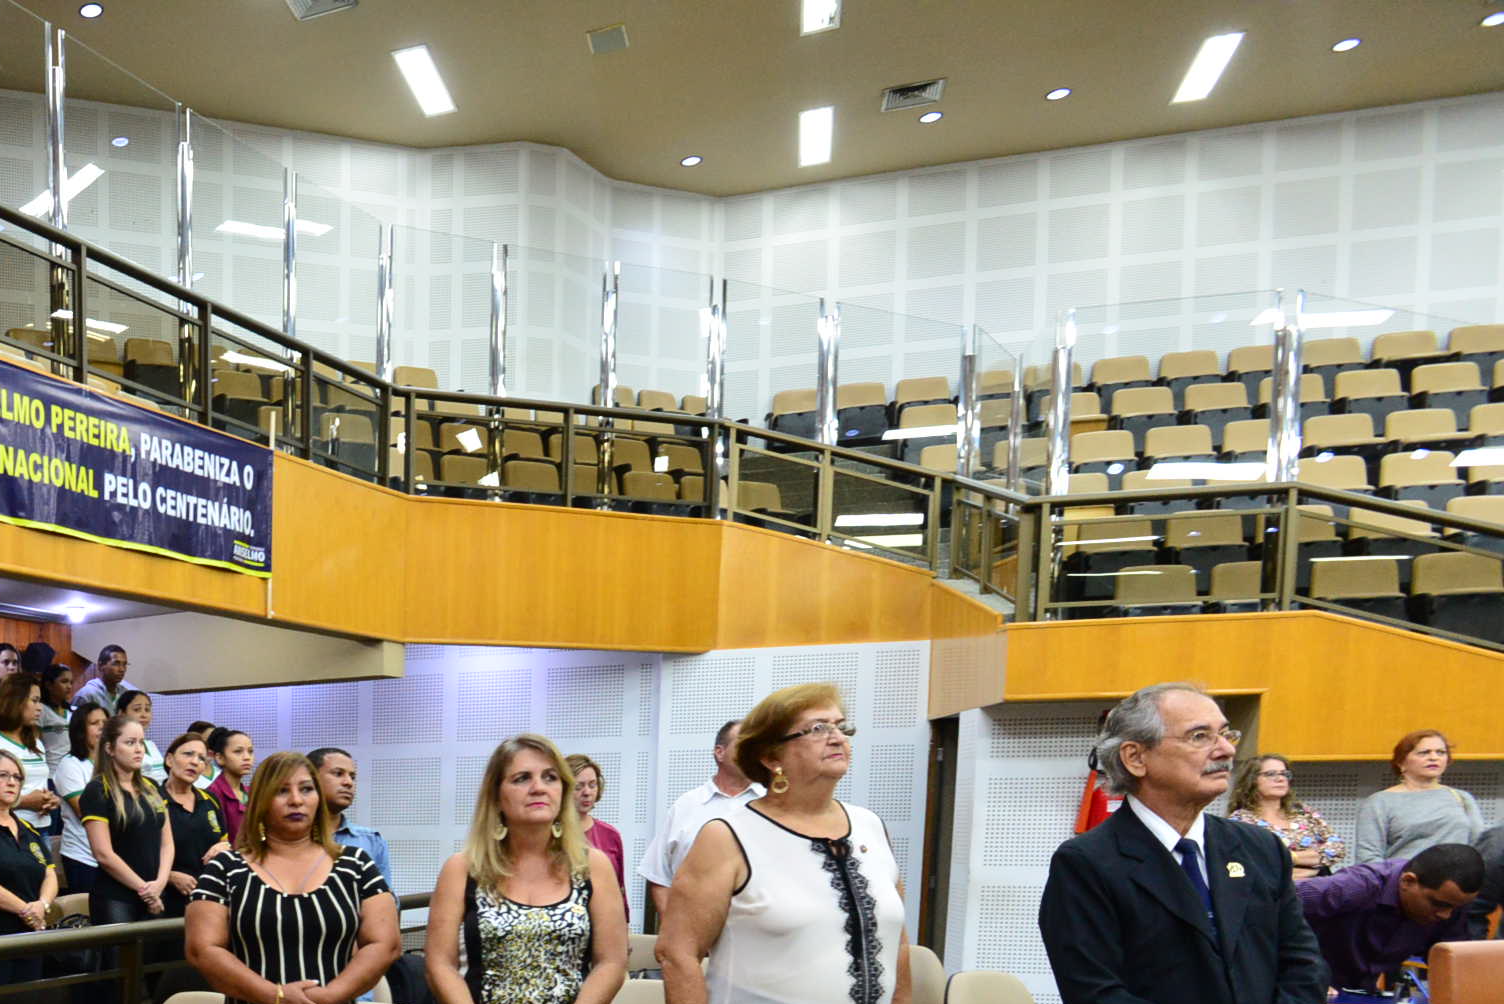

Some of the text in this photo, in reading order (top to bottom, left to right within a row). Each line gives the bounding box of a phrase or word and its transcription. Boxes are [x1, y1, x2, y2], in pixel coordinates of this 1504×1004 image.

[50, 405, 136, 462] PEREIRA,
[139, 432, 242, 484] PARABENIZA
[242, 464, 255, 490] O
[103, 472, 152, 510] PELO
[155, 489, 255, 538] CENTENÁRIO.
